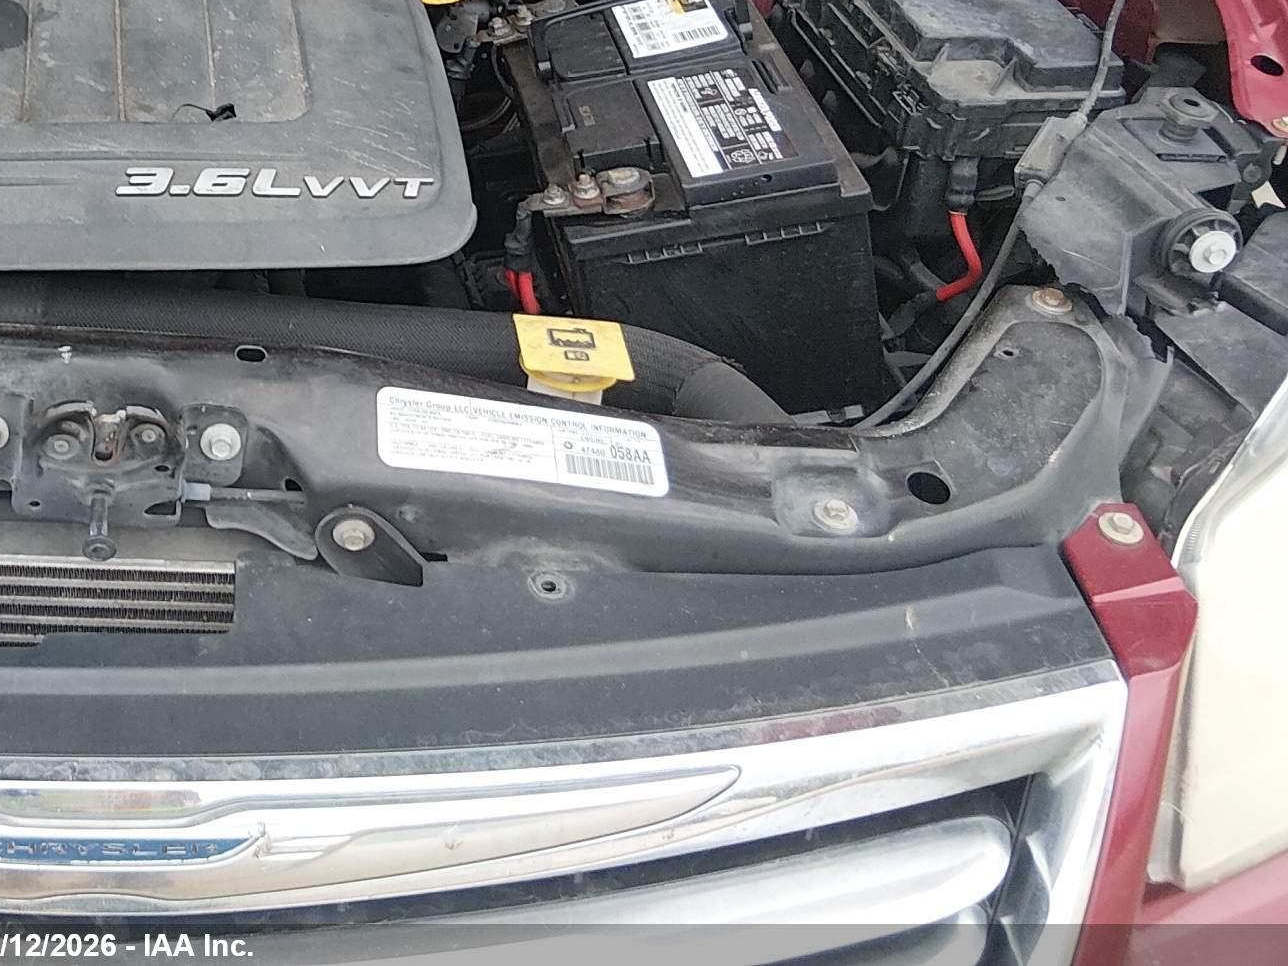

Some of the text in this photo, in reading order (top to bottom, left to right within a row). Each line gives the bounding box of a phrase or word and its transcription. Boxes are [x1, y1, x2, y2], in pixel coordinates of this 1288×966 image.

[425, 401, 452, 414] Group
[454, 404, 470, 415] LLC
[472, 407, 507, 420] VEHICLE
[509, 412, 549, 426] EMISSION
[550, 418, 587, 432] CONTROL
[590, 424, 648, 438] INFORMATION
[610, 445, 652, 463] 058AA
